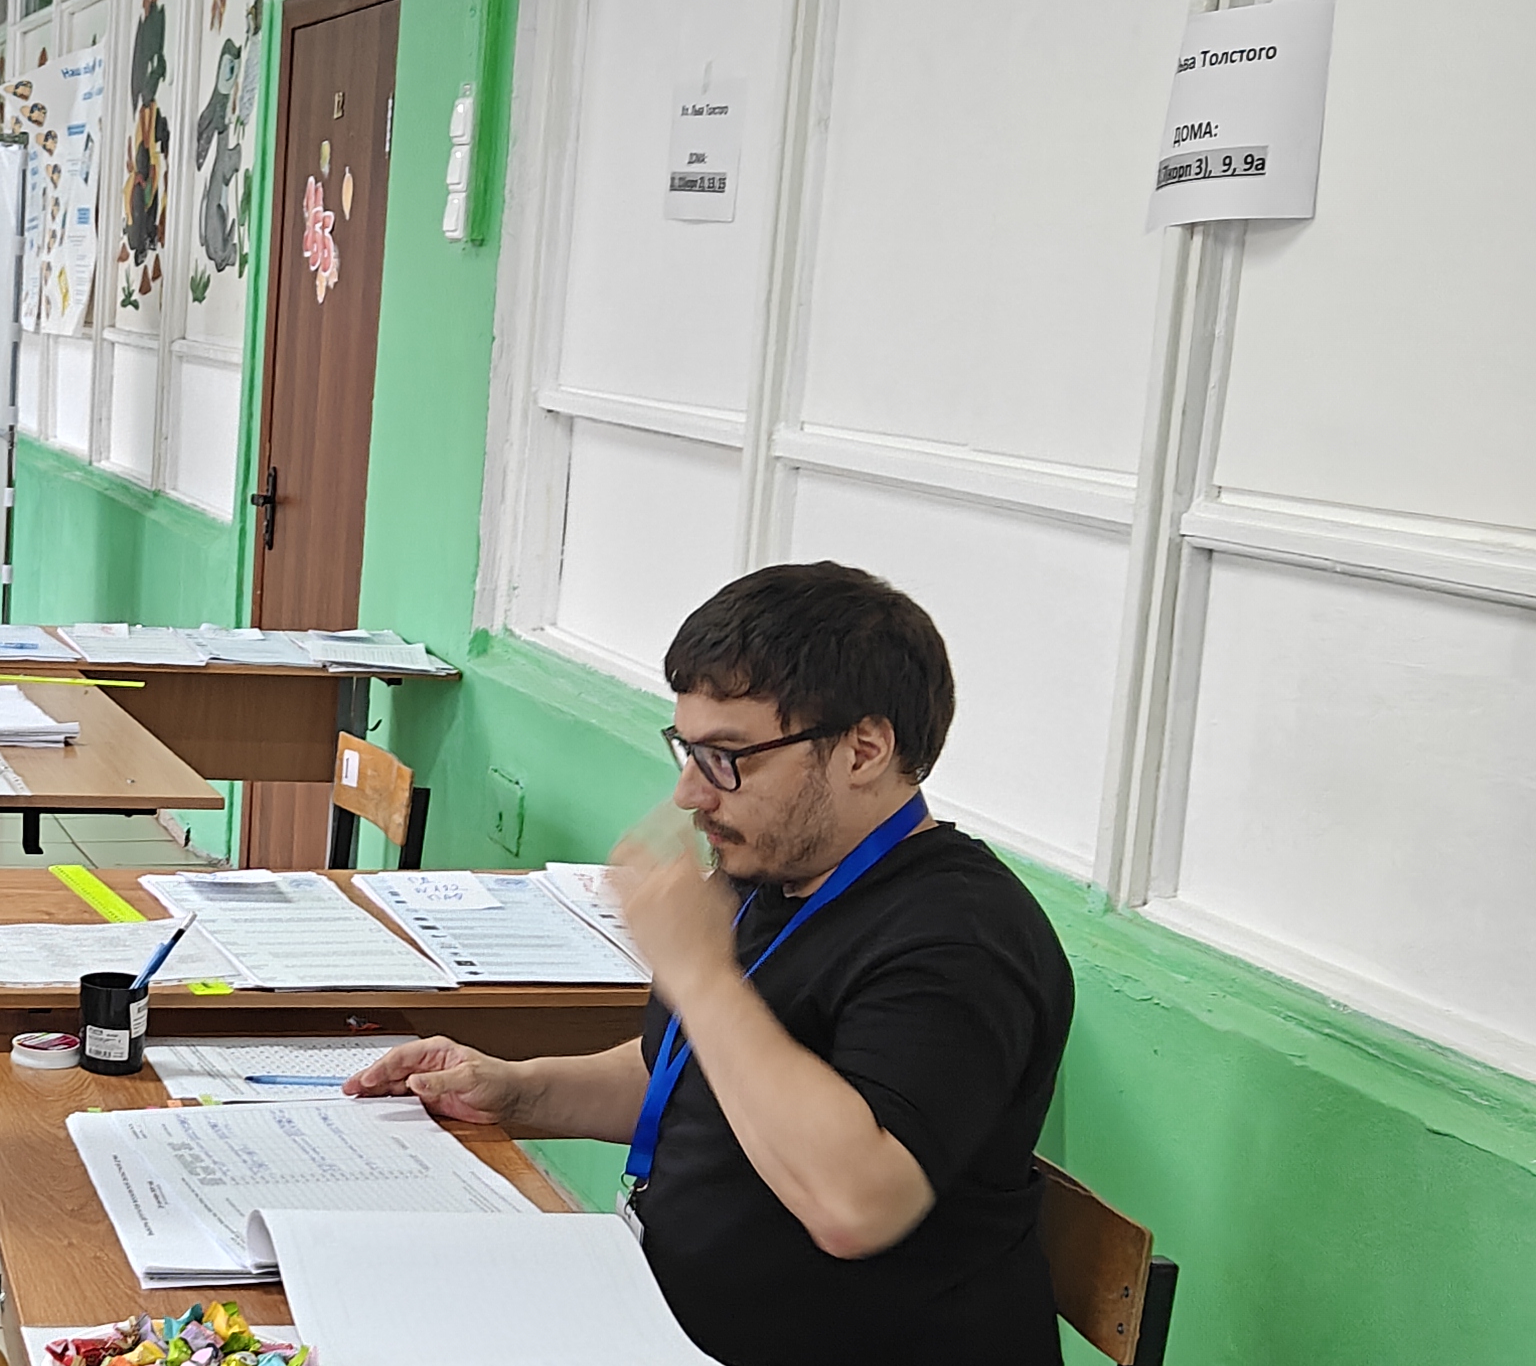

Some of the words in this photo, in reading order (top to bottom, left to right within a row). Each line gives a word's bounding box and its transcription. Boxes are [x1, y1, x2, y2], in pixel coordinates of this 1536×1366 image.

[1200, 45, 1278, 68] Толстого
[1173, 121, 1219, 148] ДОМА:
[1221, 155, 1237, 176] 9,
[1242, 154, 1266, 172] 9а
